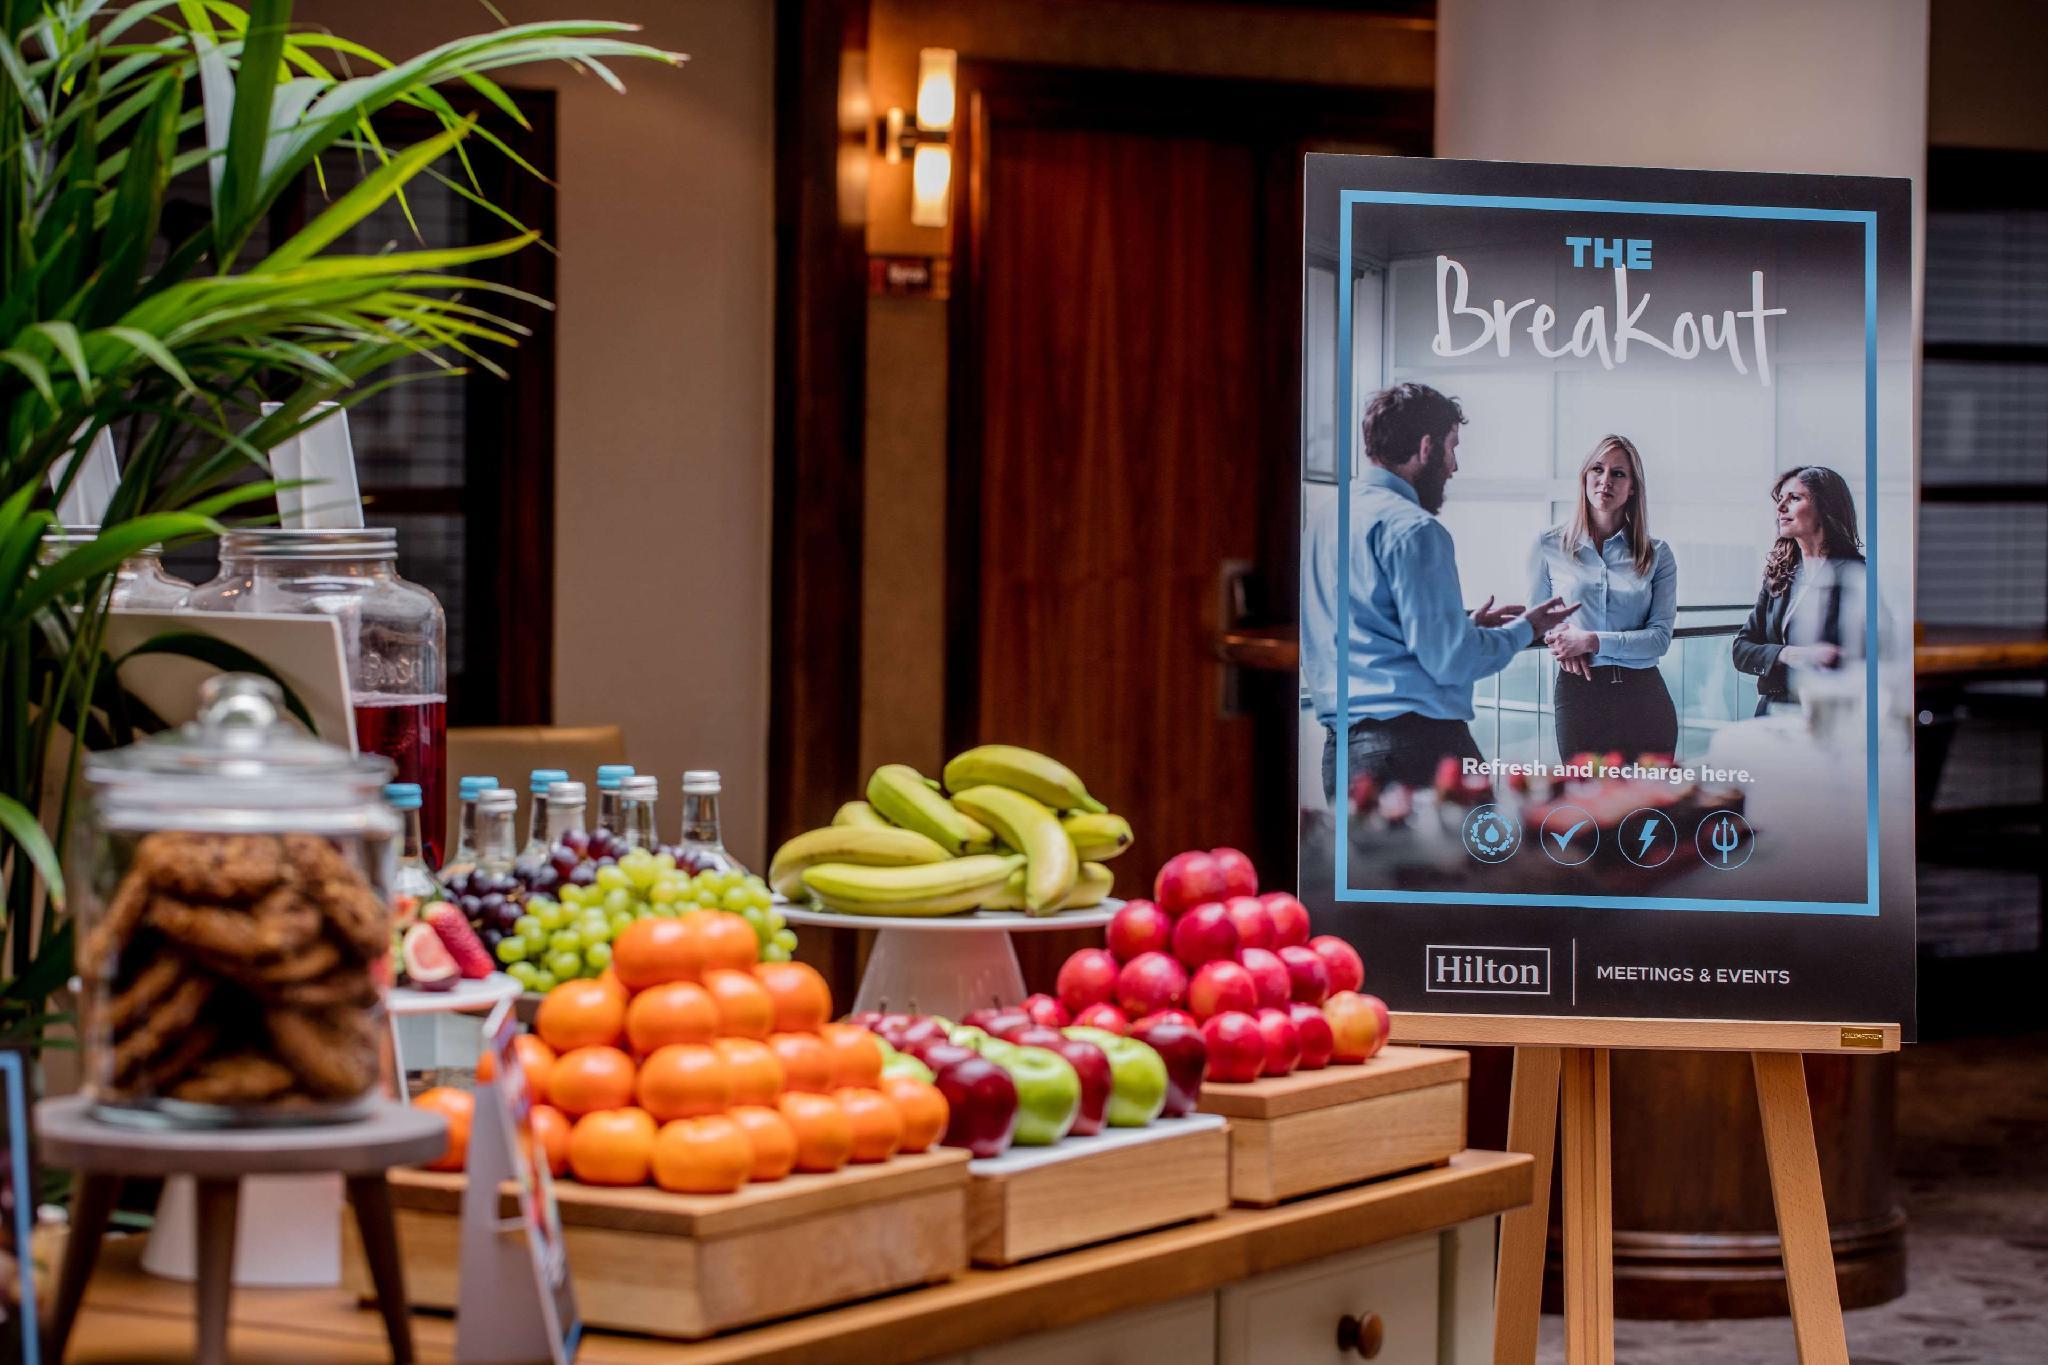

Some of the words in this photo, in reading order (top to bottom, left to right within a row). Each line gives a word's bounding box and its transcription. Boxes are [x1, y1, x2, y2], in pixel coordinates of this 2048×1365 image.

[1566, 236, 1652, 270] THE
[1432, 255, 1788, 387] Breakout
[1462, 757, 1547, 777] Refresh
[1553, 761, 1593, 778] and
[1599, 764, 1695, 785] recharge
[1701, 765, 1755, 783] here.
[1435, 955, 1541, 985] Hilton
[1597, 965, 1694, 982] MEETINGS
[1699, 968, 1711, 982] &
[1716, 968, 1790, 984] EVENTS
